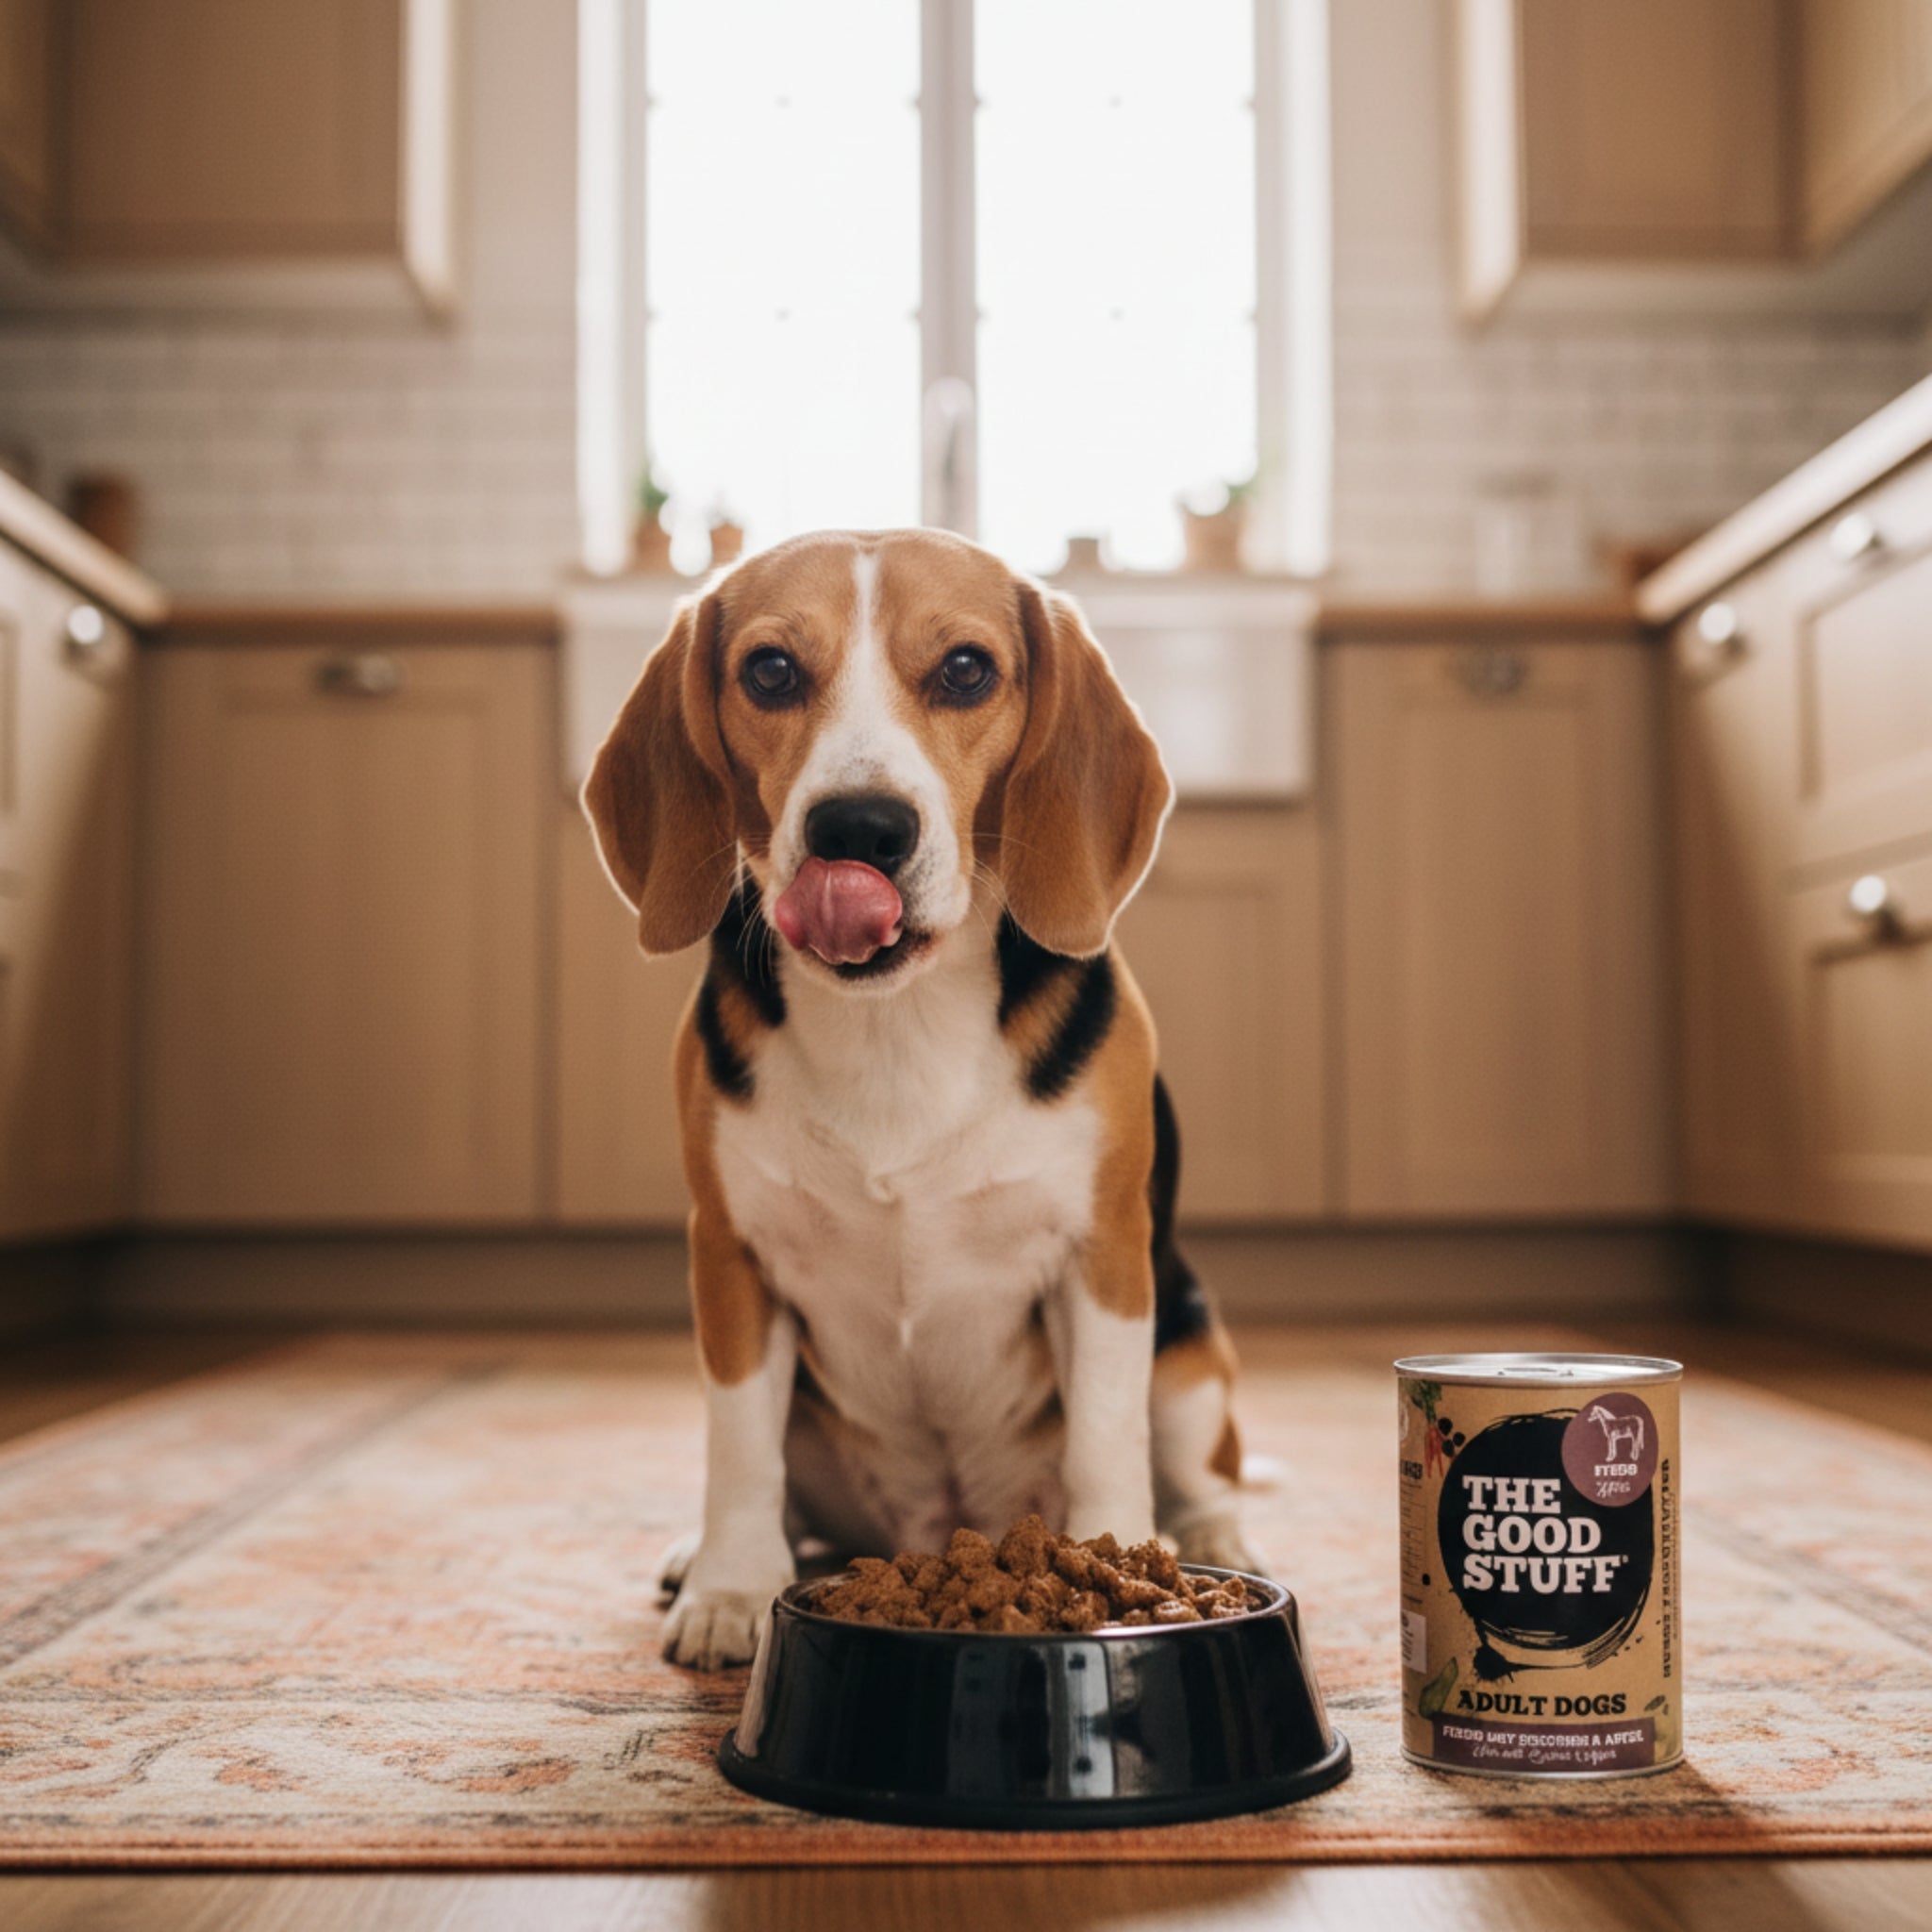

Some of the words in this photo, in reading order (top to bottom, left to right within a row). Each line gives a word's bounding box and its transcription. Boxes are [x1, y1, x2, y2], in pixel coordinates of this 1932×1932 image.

[1462, 1474, 1561, 1514] THE
[1462, 1513, 1602, 1554] GOOD
[1457, 1690, 1548, 1717] ADULT
[1554, 1693, 1627, 1717] DOGS
